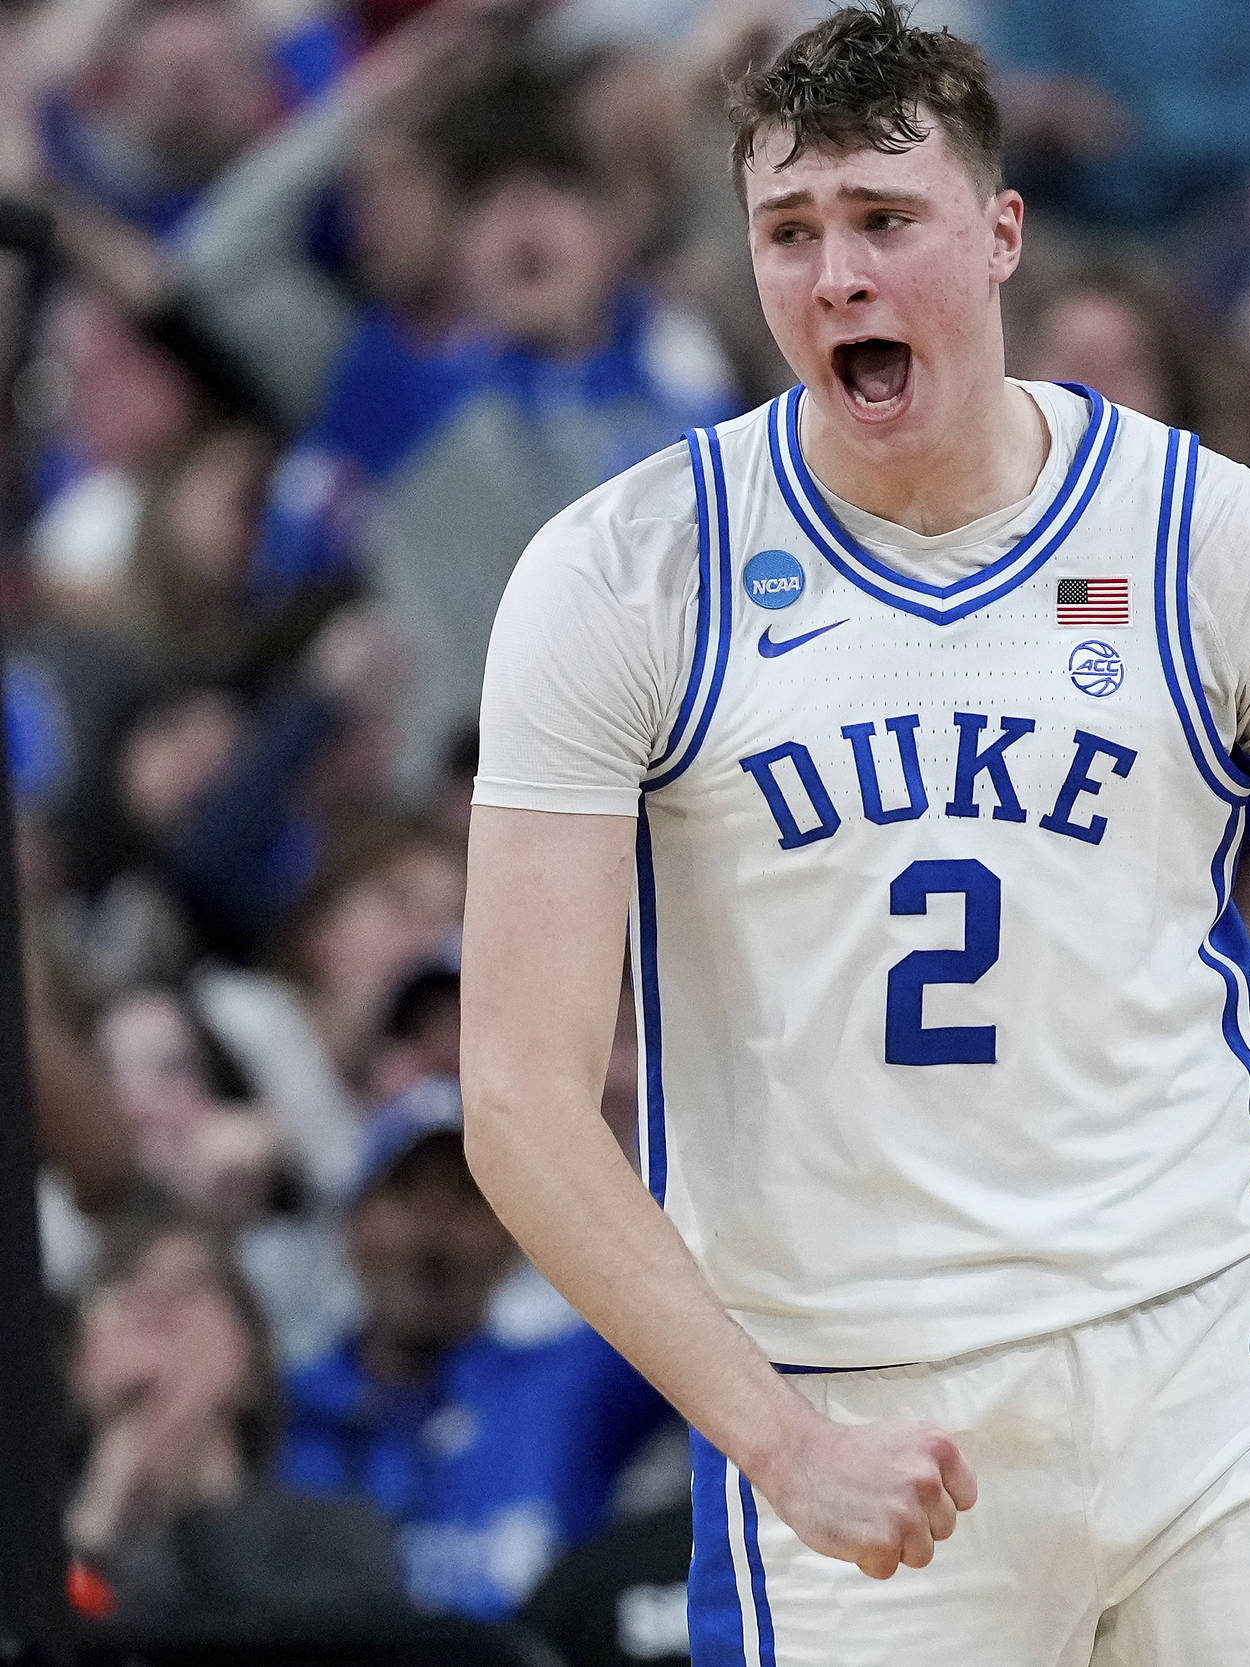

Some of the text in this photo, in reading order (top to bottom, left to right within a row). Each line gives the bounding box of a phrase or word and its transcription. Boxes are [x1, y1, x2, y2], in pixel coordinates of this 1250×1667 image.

[752, 576, 801, 595] NCAA
[1076, 659, 1121, 672] ACC
[740, 711, 1138, 850] DUKE
[885, 858, 1002, 1066] 2
